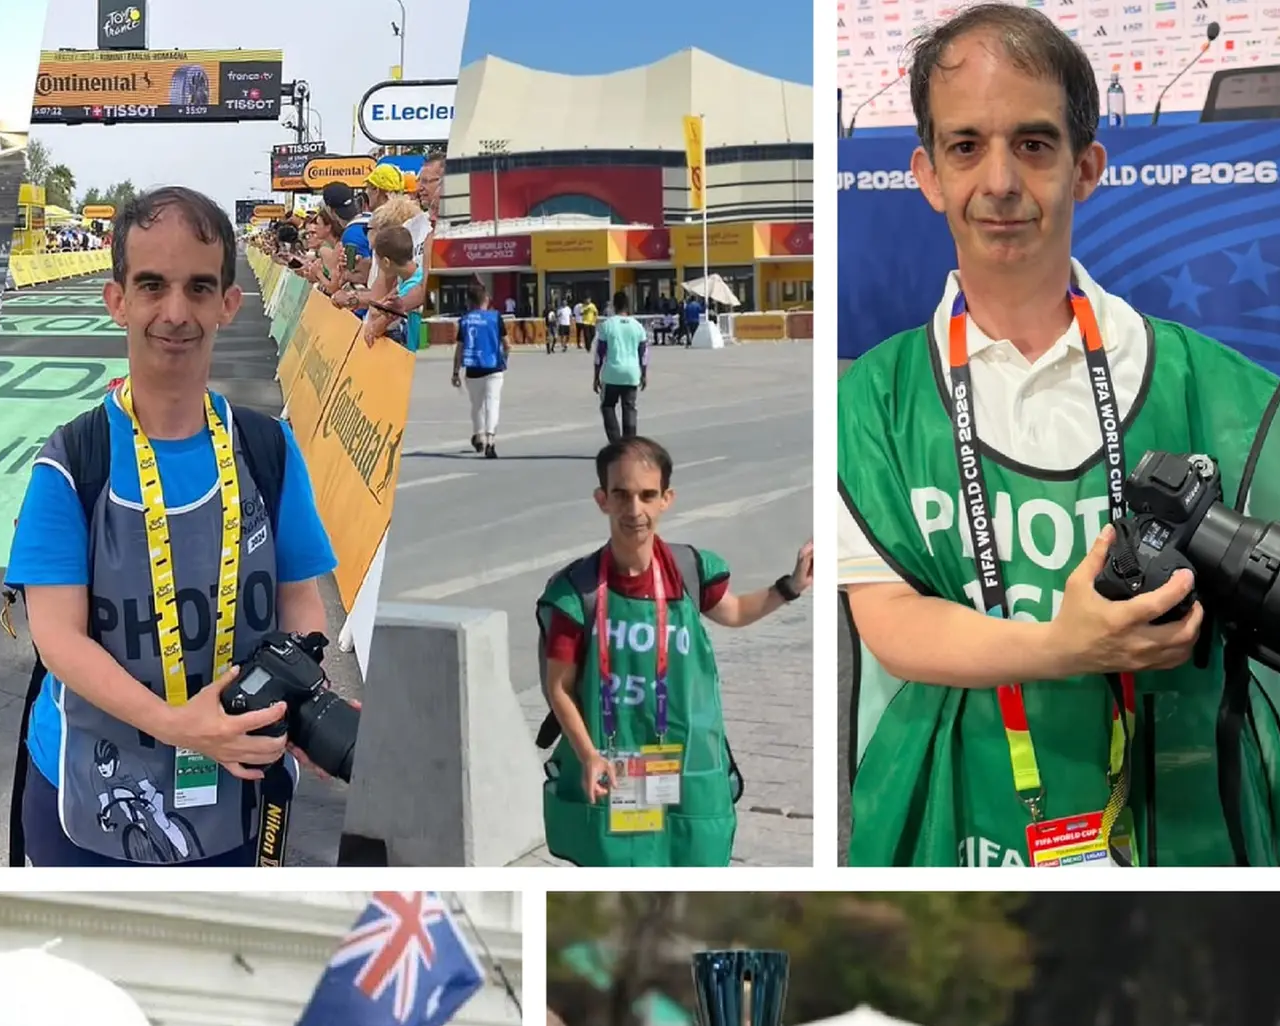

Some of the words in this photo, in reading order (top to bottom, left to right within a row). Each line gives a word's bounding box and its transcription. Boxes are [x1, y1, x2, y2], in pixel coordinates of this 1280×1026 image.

[36, 72, 136, 96] Continental
[103, 105, 158, 117] TISSOT
[225, 99, 274, 109] TISSOT
[288, 143, 323, 154] TISSOT
[308, 165, 365, 179] Continental
[857, 171, 919, 190] 2026
[1096, 168, 1136, 187] RLD
[1141, 165, 1188, 186] CUP
[1191, 161, 1280, 185] 2026
[1092, 366, 1111, 403] FIFA
[955, 383, 972, 442] 2026
[323, 376, 393, 486] Continental
[1100, 403, 1120, 466] WORLD
[960, 445, 979, 480] CUP
[1110, 468, 1122, 504] CUP
[910, 486, 1110, 570] PHOT
[967, 482, 990, 548] WORLD
[981, 550, 999, 588] FIFA
[592, 618, 691, 655] HOTO
[263, 803, 282, 855] Nikon
[1035, 837, 1052, 847] FIFA
[1052, 832, 1081, 843] WORLD
[1081, 828, 1097, 838] CUP
